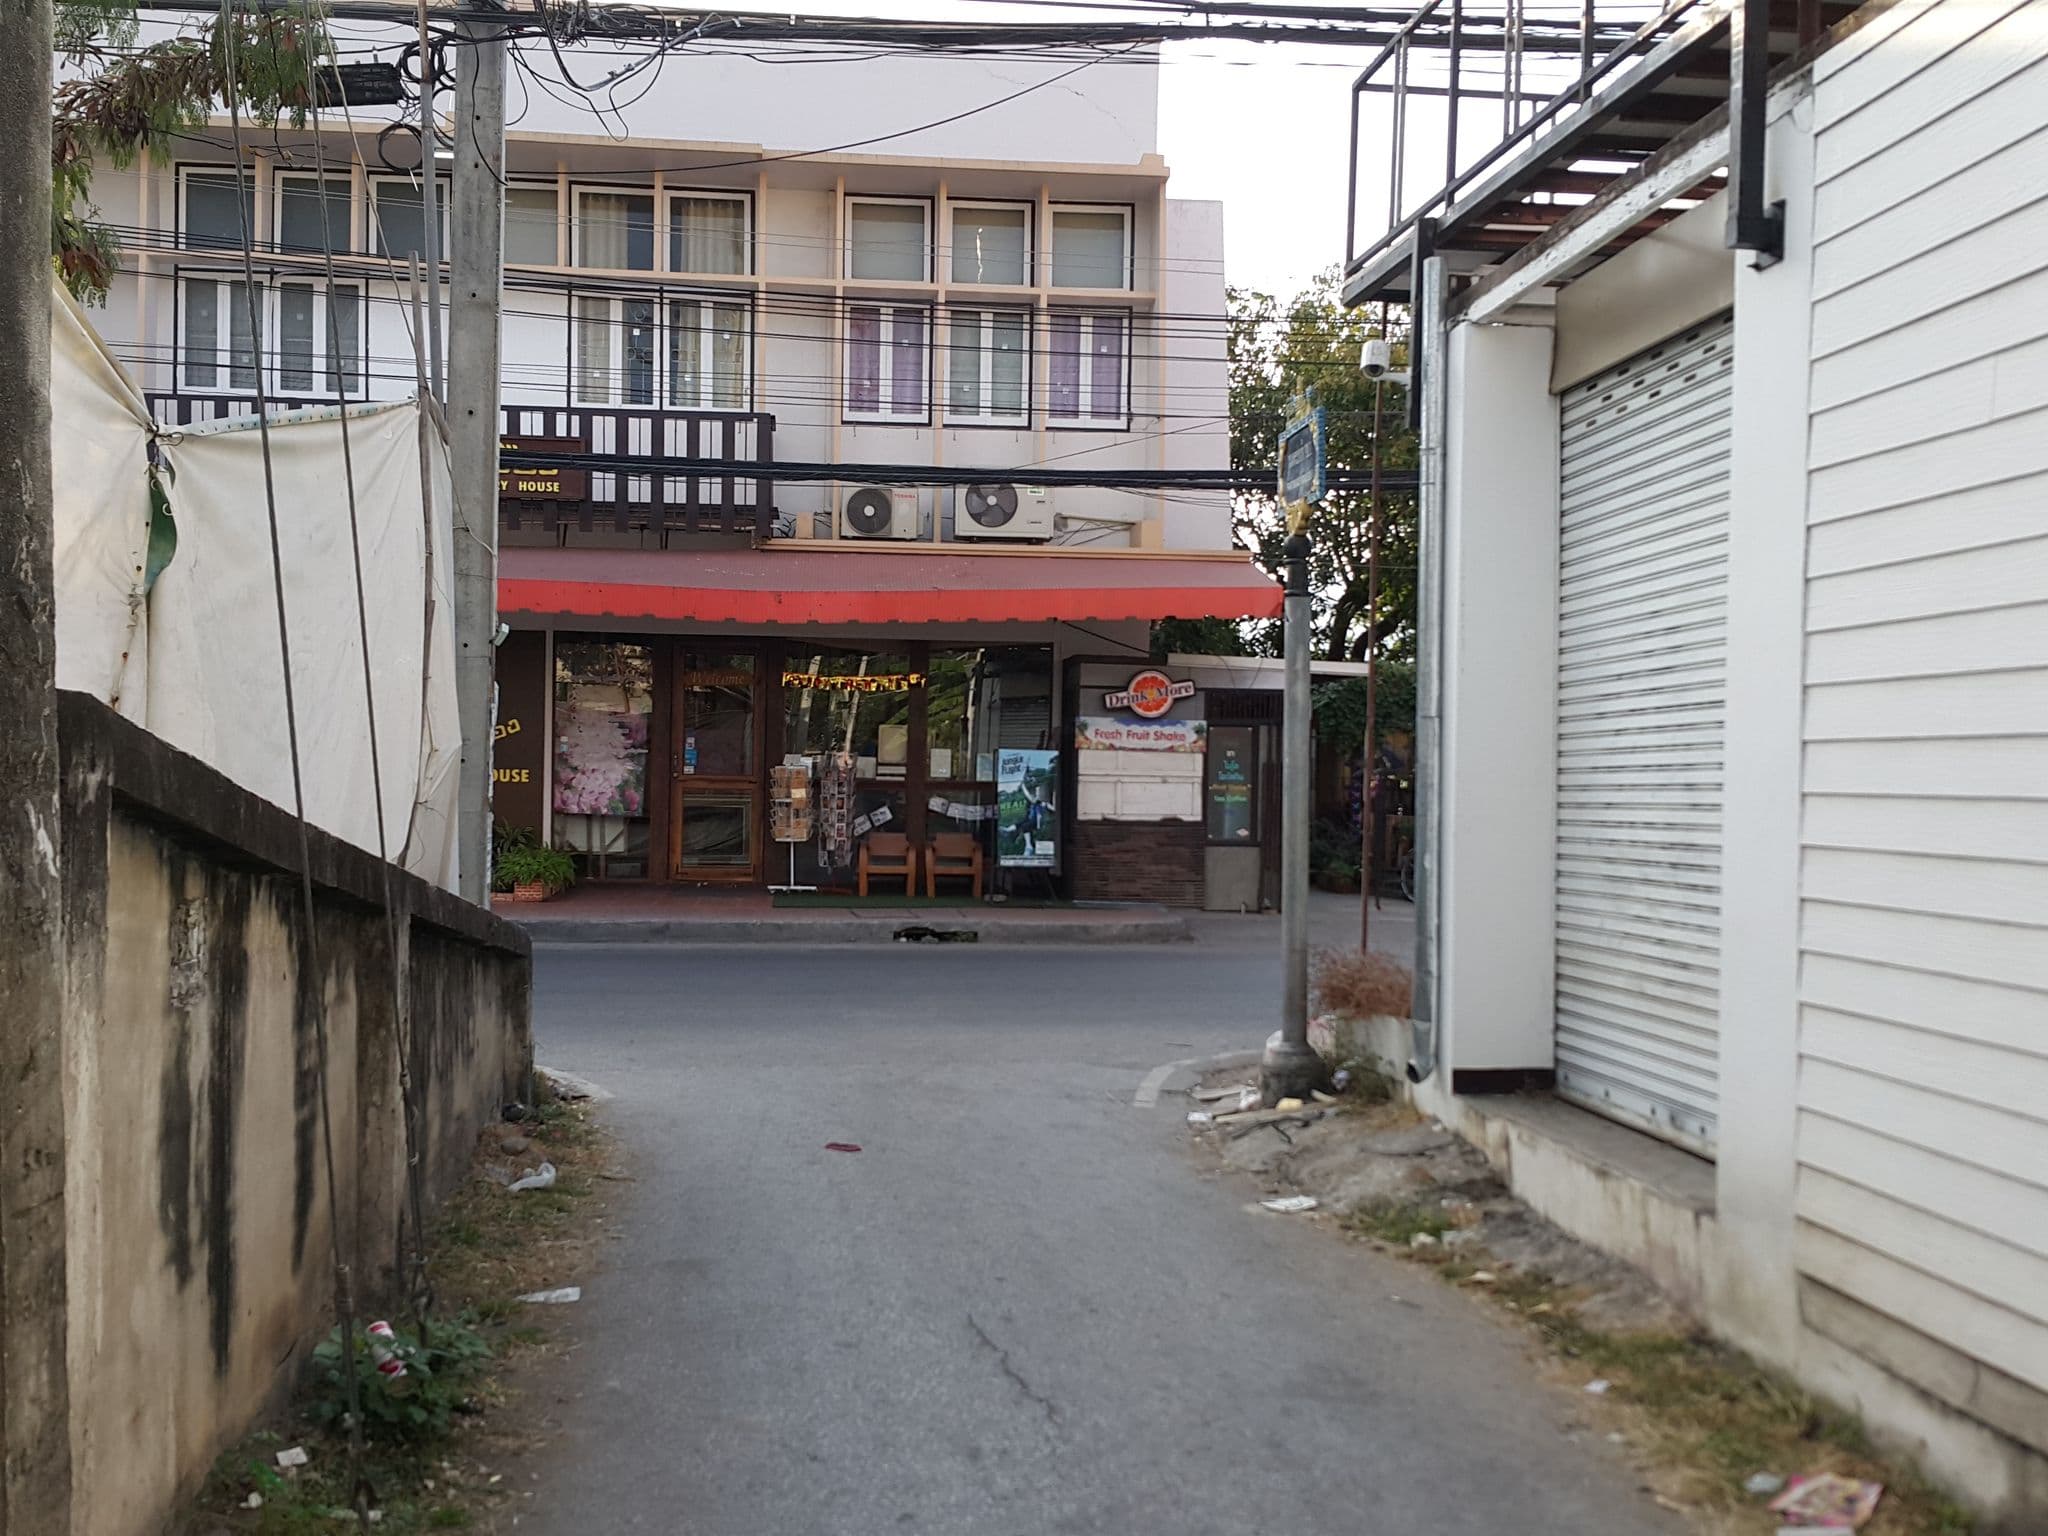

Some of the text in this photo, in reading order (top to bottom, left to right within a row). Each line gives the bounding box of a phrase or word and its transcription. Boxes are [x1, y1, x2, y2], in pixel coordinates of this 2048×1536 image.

[518, 481, 560, 493] HOUSE
[1108, 684, 1192, 707] Drink More
[1094, 728, 1186, 742] Fresh Fruit Shake
